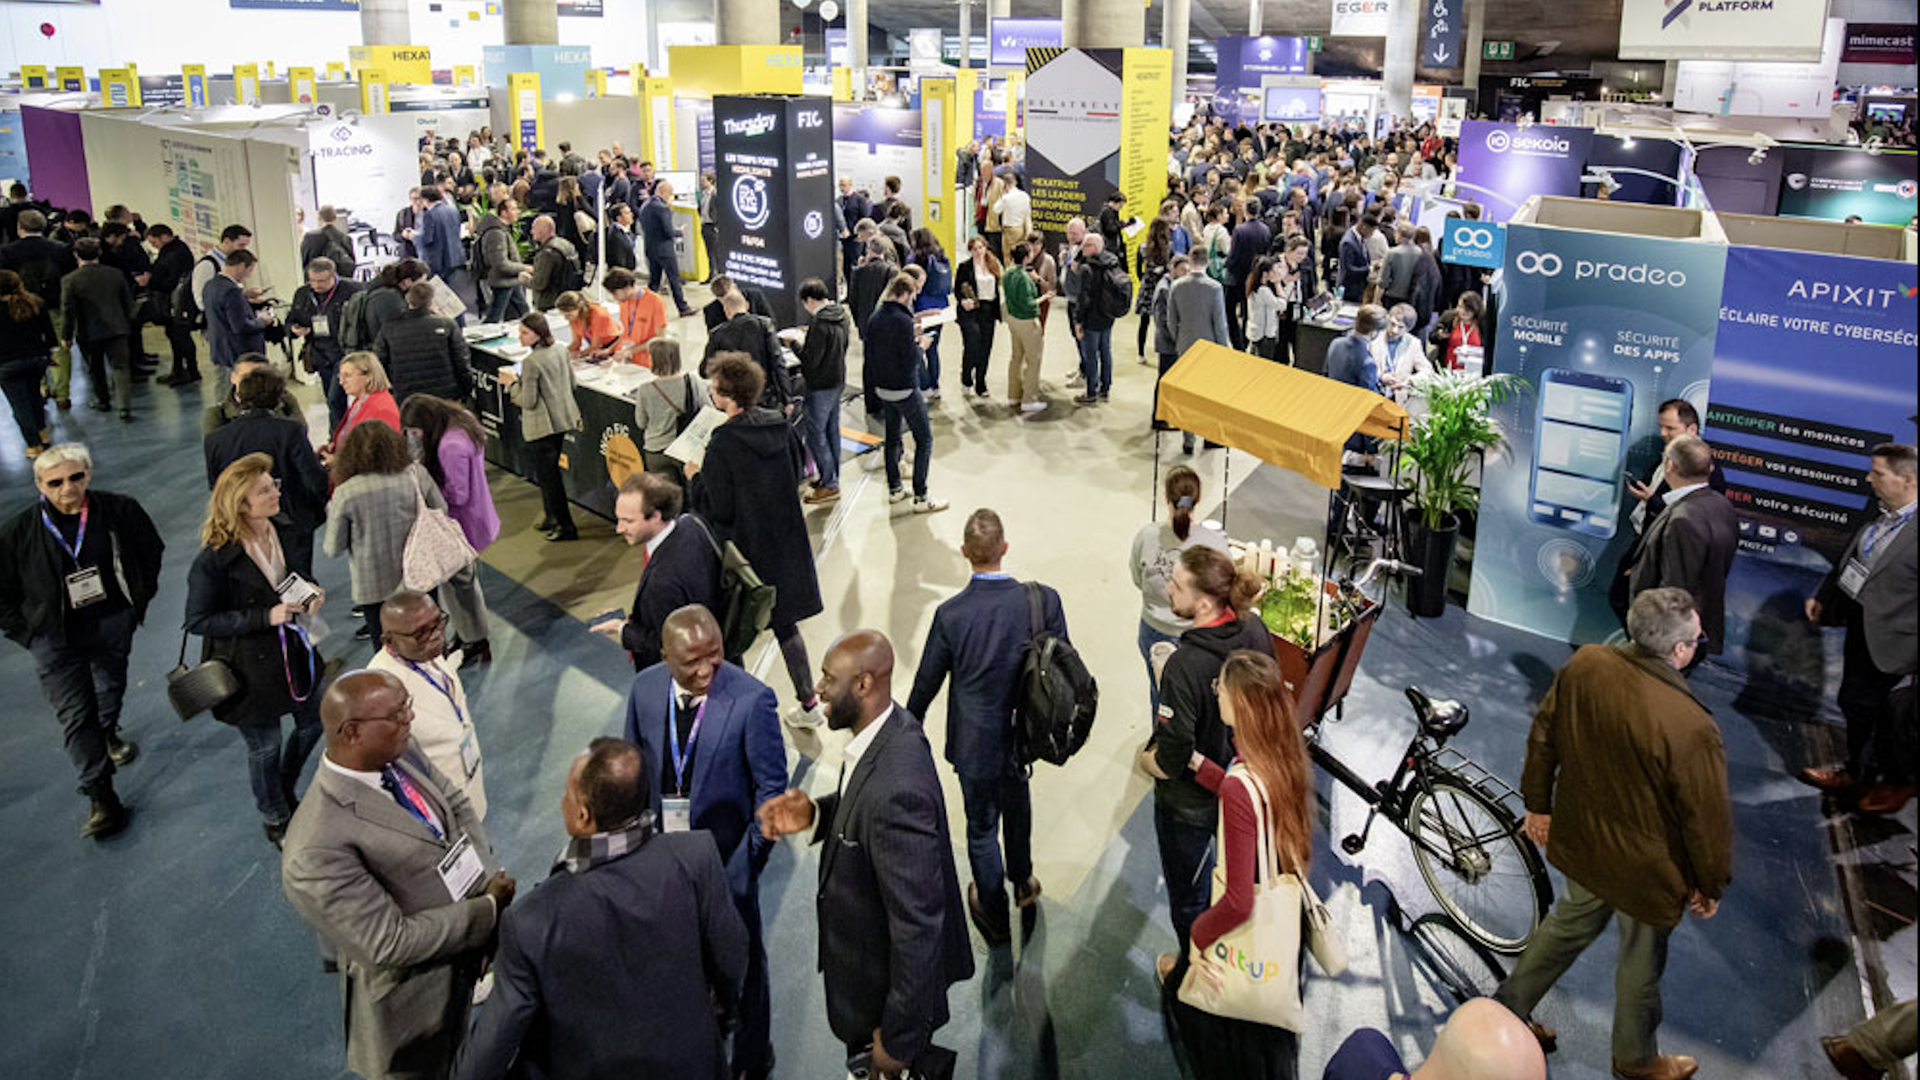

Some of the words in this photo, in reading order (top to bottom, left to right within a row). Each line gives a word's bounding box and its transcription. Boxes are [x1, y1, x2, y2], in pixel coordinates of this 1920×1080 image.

[1336, 1, 1389, 13] EGER
[1699, 1, 1773, 11] PLATFORM
[1850, 35, 1914, 47] mimecast
[723, 112, 776, 135] Thursday
[797, 110, 823, 128] FIC
[1512, 135, 1570, 151] sekoia
[1032, 178, 1080, 189] HEXATRUST
[1032, 188, 1048, 198] LES
[1050, 190, 1086, 202] LEADERS
[1032, 199, 1081, 212] EUROPÉENS
[1032, 210, 1044, 220] DU
[1453, 247, 1493, 259] pradeo
[1576, 259, 1687, 287] pradeo
[1787, 279, 1897, 308] APIXIT
[1510, 315, 1569, 333] SÉCURITÉ
[1719, 306, 1780, 328] ÉCLAIRE
[1783, 317, 1830, 335] VOTRE
[1513, 329, 1564, 346] MOBILE
[1616, 330, 1680, 349] SÉCURITÉ
[1614, 344, 1641, 358] DES
[1644, 347, 1681, 363] APPS
[1707, 410, 1777, 431] ANTICIPER
[1778, 422, 1799, 437] les
[1803, 428, 1866, 448] menaces
[1711, 449, 1764, 468] ROTÉGER
[1765, 460, 1787, 474] vos
[1788, 466, 1858, 486] ressources
[1724, 488, 1752, 503] RER
[1755, 497, 1790, 512] votre
[1792, 503, 1848, 525] sécurité
[1738, 539, 1776, 554] PIXIT.FR
